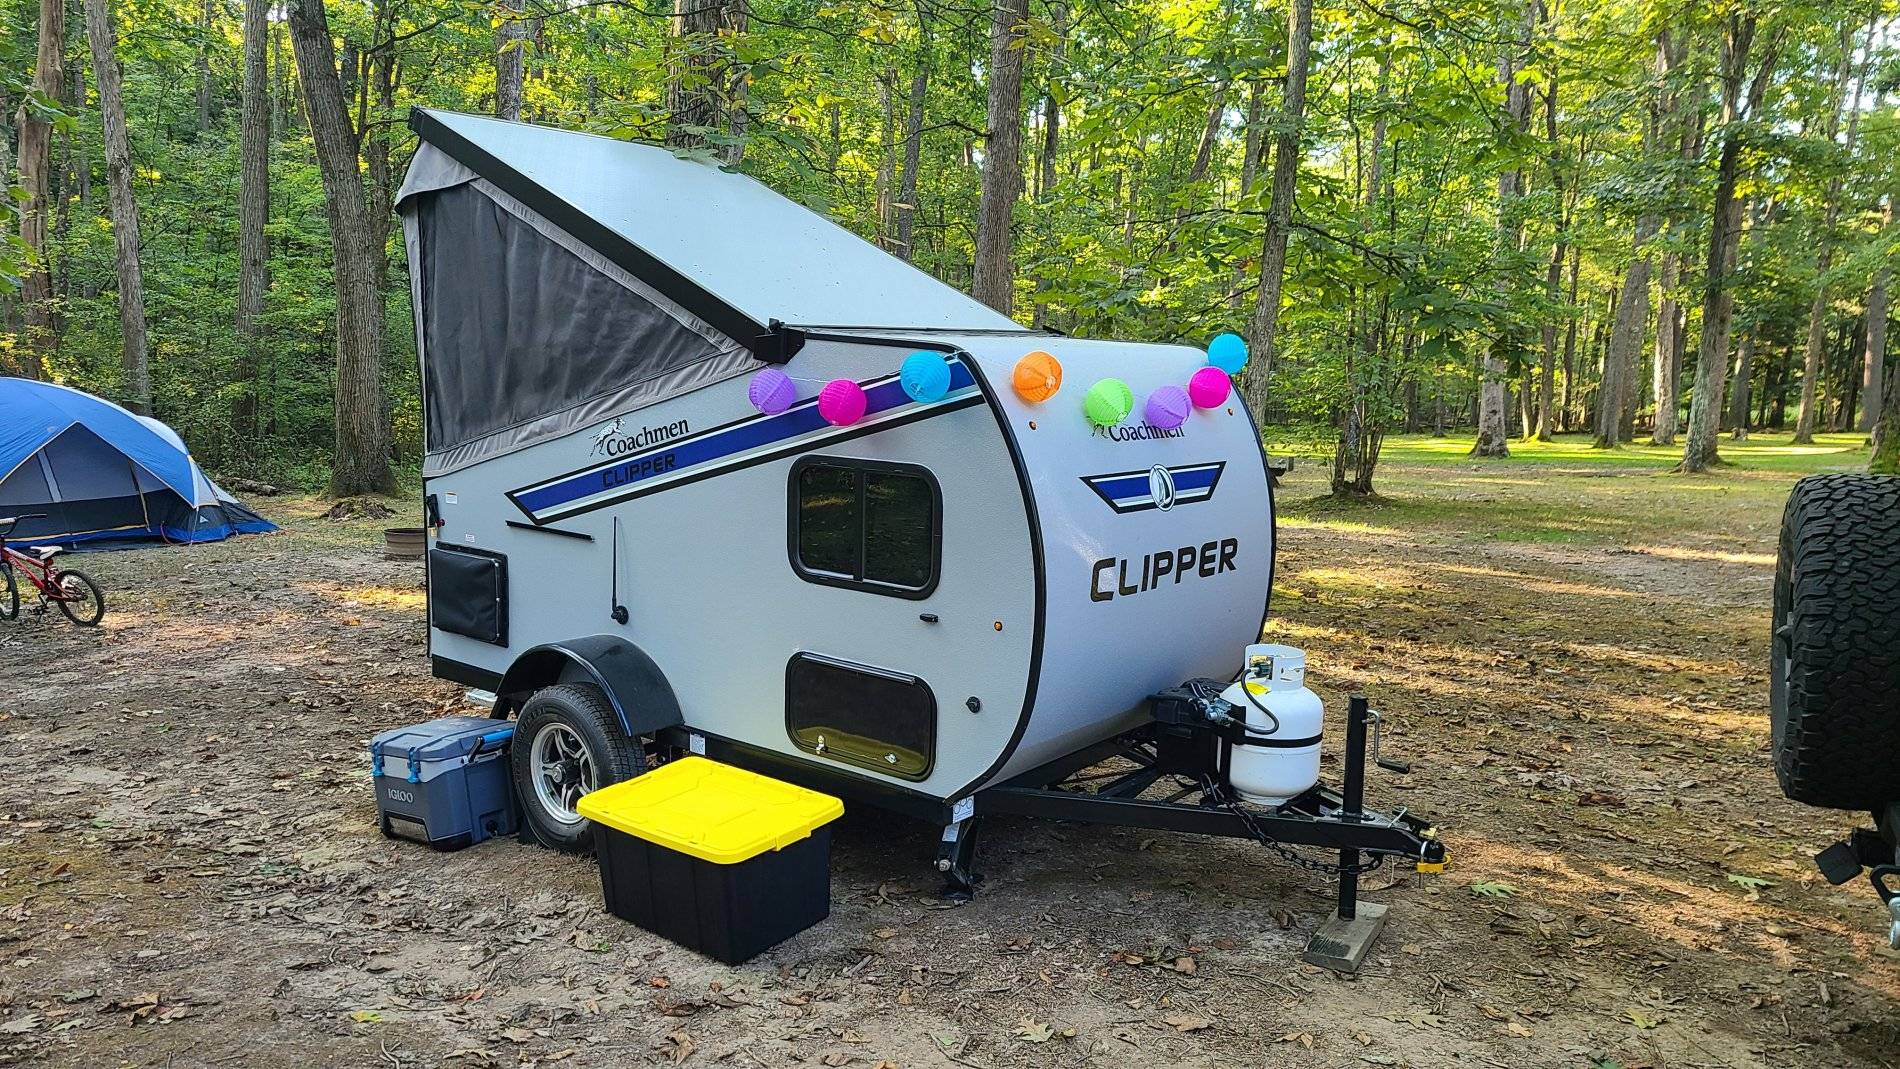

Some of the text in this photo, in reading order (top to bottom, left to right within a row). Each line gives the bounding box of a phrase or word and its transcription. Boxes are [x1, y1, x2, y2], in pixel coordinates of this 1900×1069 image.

[606, 418, 690, 456] Coachmen
[603, 453, 676, 487] CLIPPER
[1090, 537, 1238, 602] CLIPPER
[388, 788, 414, 803] IGLOO
